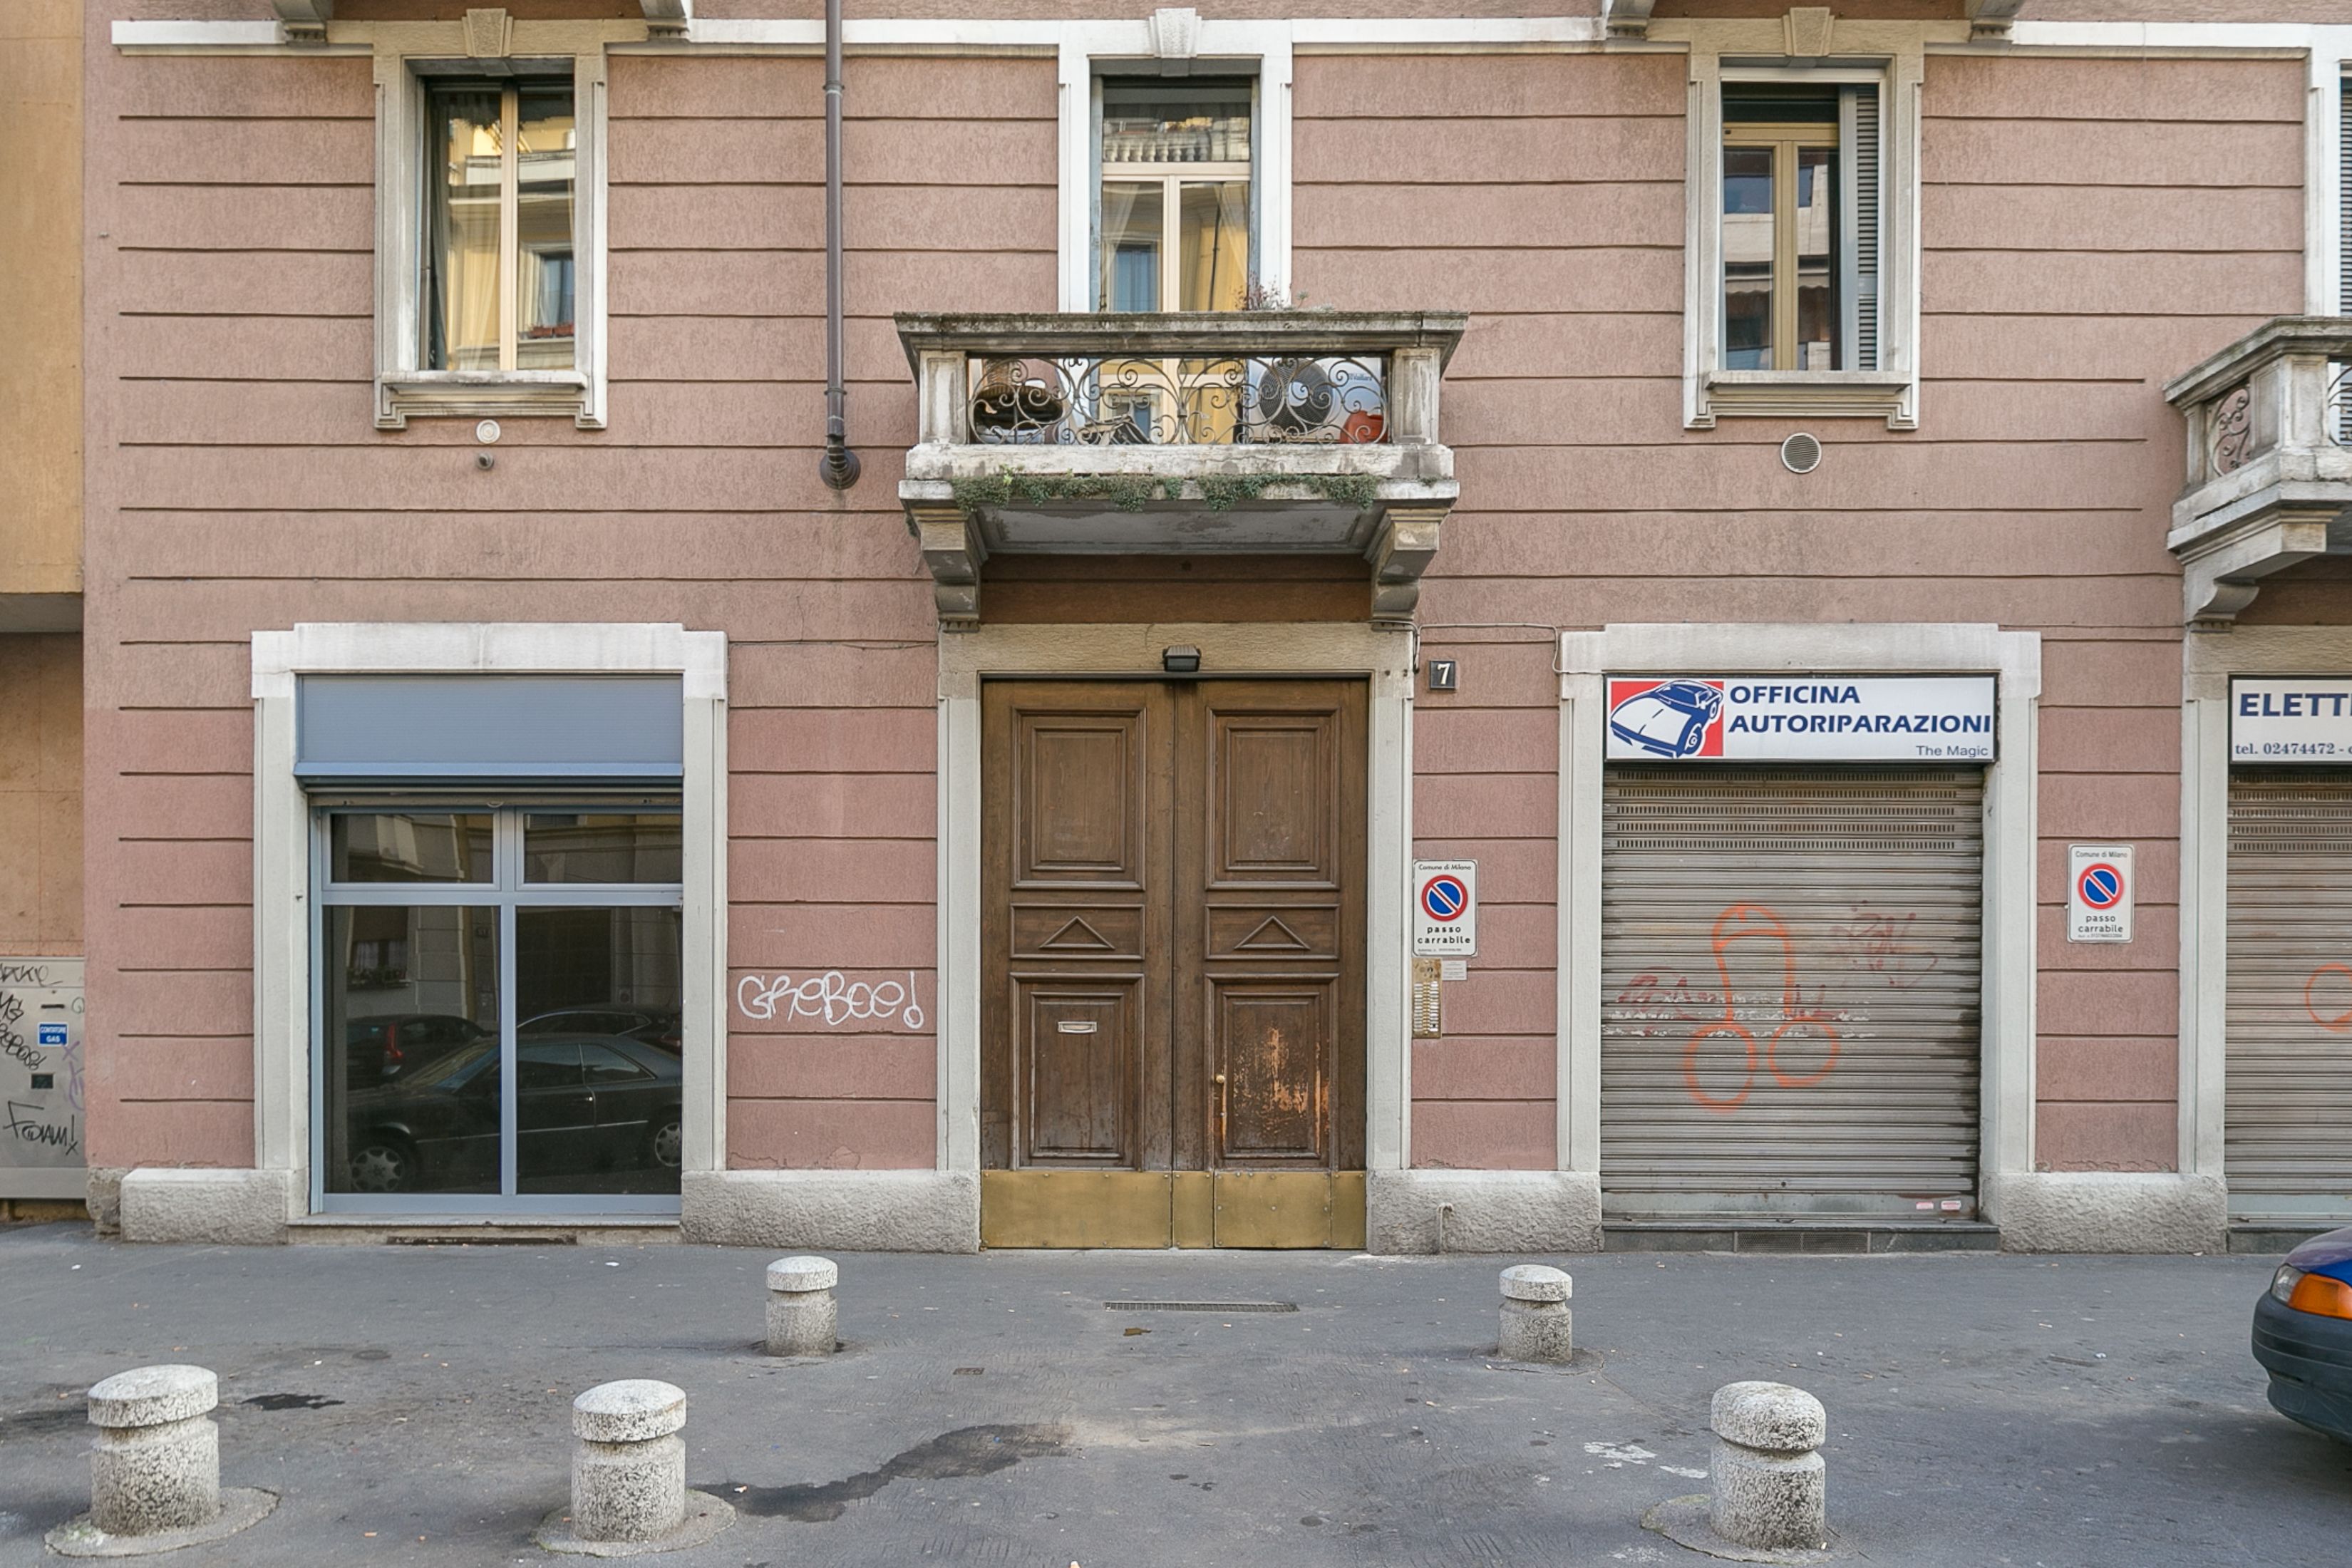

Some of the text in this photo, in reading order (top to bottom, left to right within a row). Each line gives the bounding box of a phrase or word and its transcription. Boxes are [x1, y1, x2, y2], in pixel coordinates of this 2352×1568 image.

[1437, 663, 1451, 685] 7
[1730, 686, 1861, 704] OFFICINA
[2239, 693, 2352, 716] ELETT
[1728, 715, 1991, 733] AUTORIPARAZIONI
[1915, 745, 1989, 758] The Magic
[2235, 743, 2258, 755] tel.
[2263, 743, 2336, 755] 02474472
[2078, 924, 2123, 932] carrabile
[1417, 935, 1471, 944] carrabile
